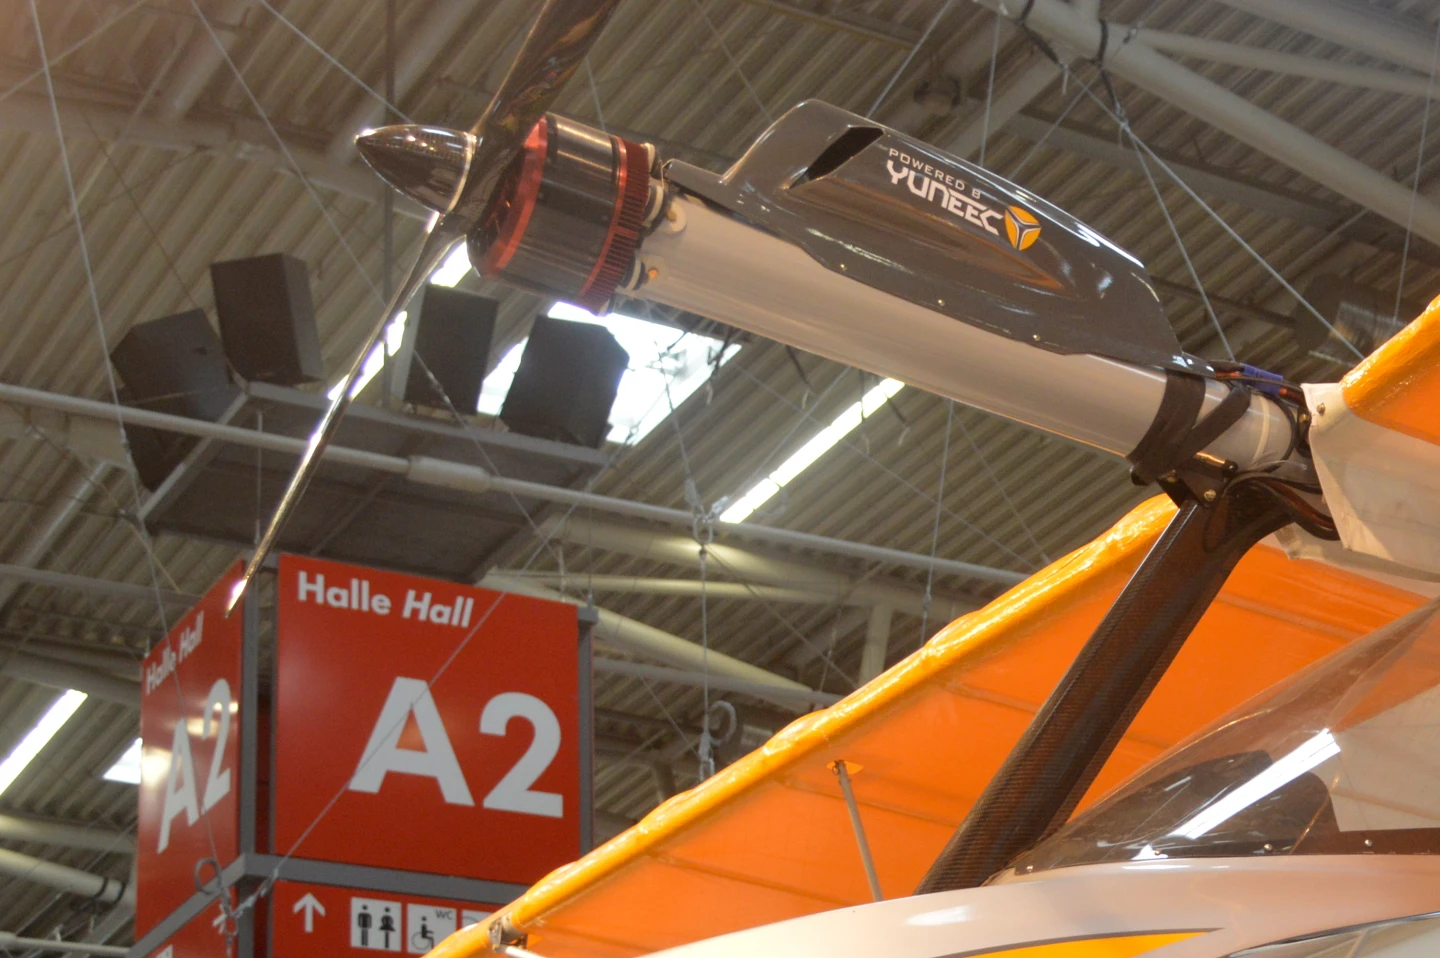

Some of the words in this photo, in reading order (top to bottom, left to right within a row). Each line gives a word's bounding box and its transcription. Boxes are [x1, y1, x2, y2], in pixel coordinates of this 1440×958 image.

[887, 159, 1004, 236] YUNEEC
[889, 148, 965, 191] POWERED
[298, 570, 391, 616] Halle
[402, 589, 474, 628] Hall
[146, 647, 177, 696] Halle
[180, 611, 204, 663] Hall
[157, 678, 232, 854] A2
[349, 676, 564, 818] A2
[435, 909, 453, 921] WC
